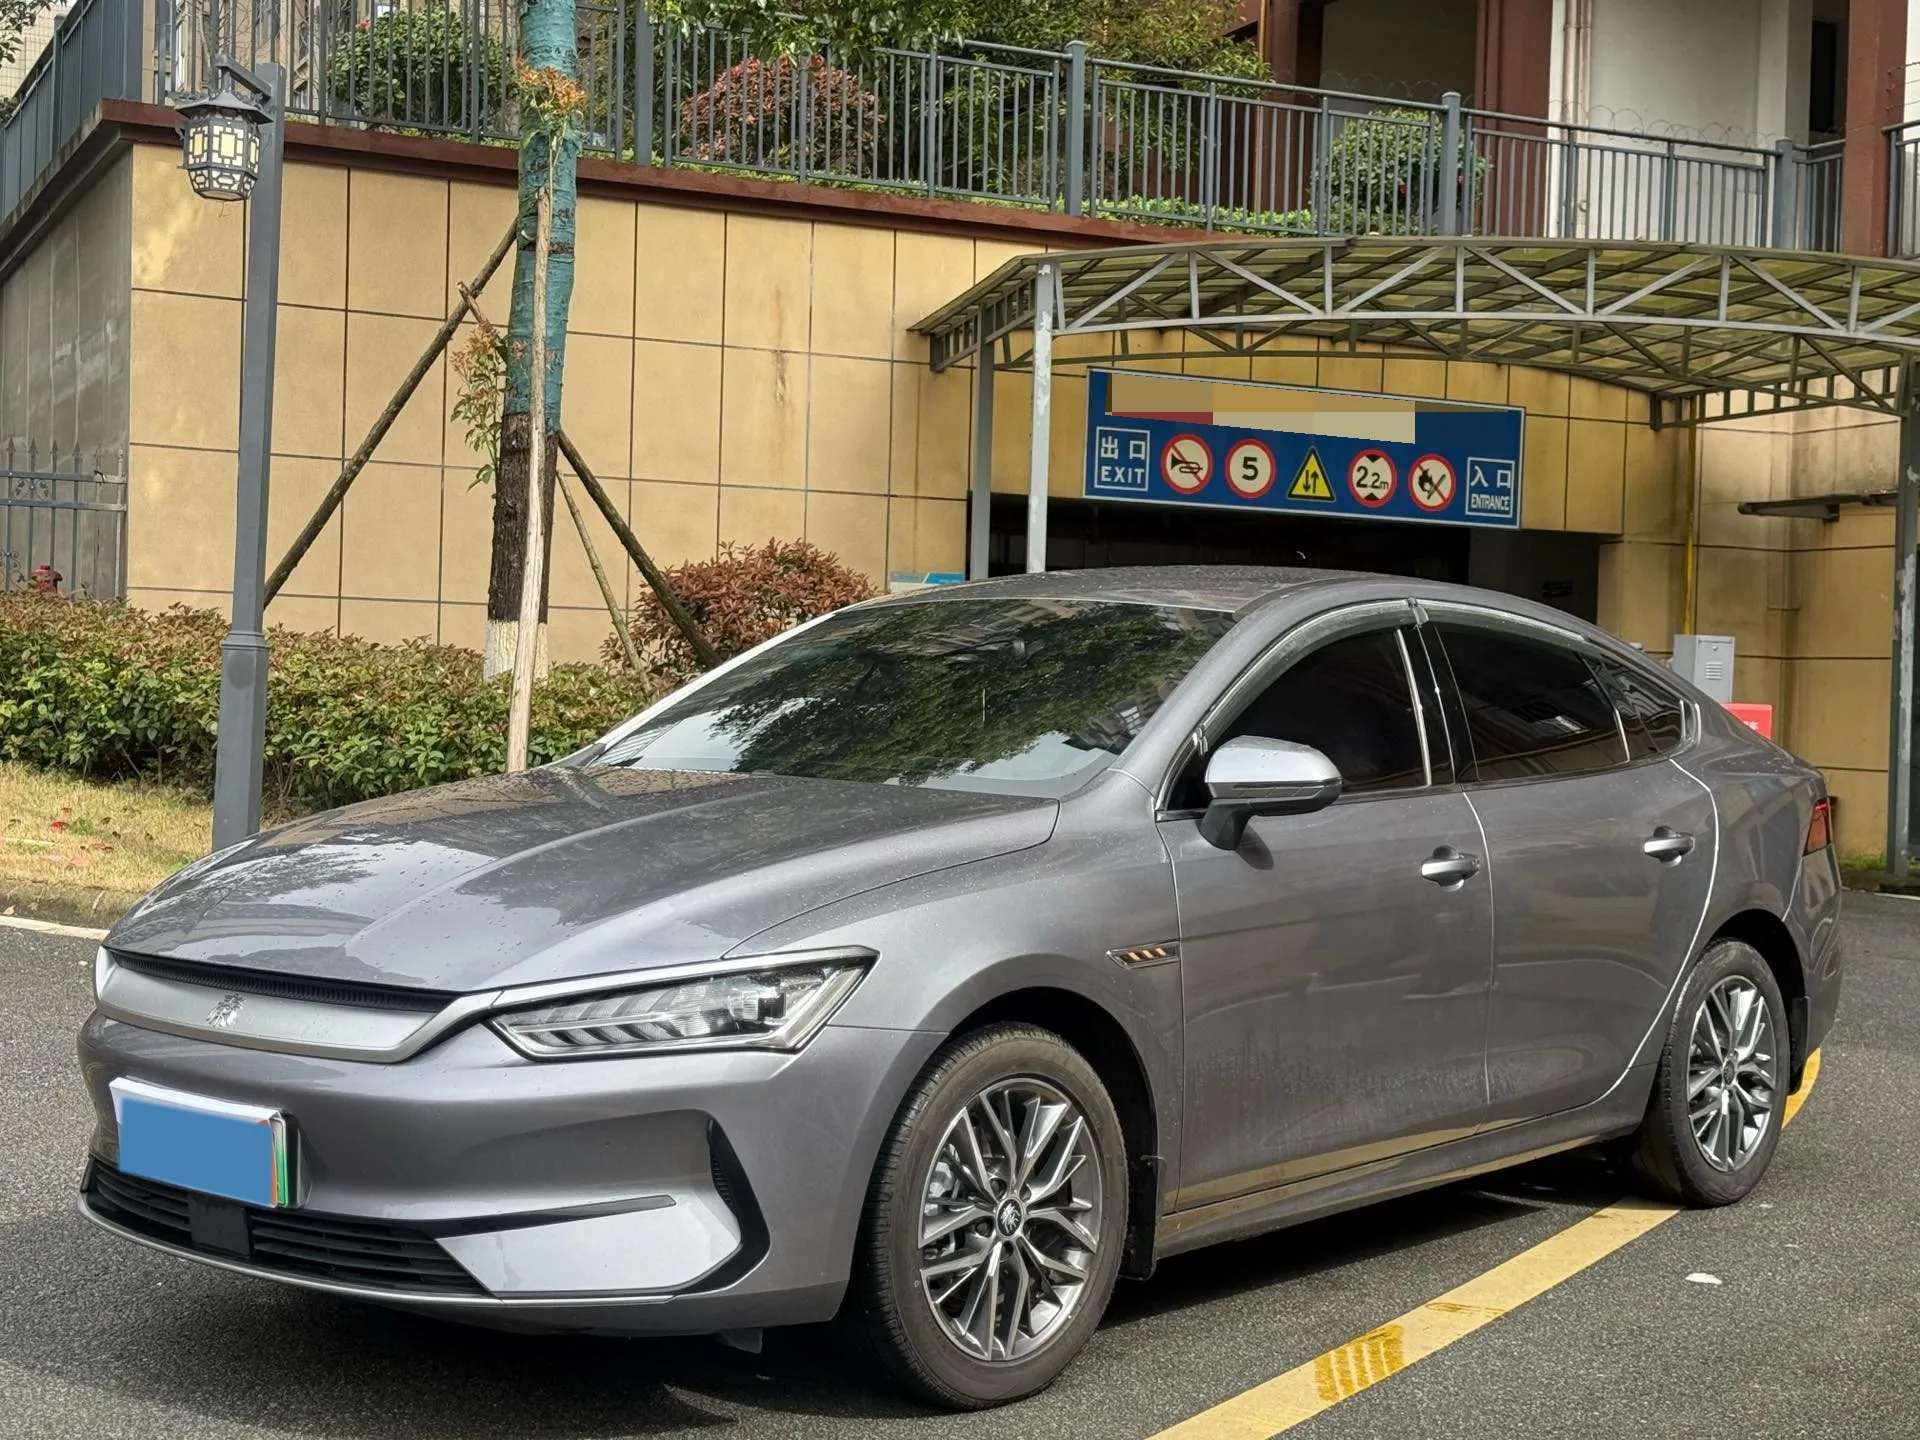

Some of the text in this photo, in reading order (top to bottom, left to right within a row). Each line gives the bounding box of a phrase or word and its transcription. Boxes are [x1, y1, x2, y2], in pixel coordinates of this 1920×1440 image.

[1100, 436, 1146, 460] 出口
[1100, 465, 1145, 484] EXIT
[1242, 456, 1259, 481] 5
[1470, 465, 1511, 488] 入口
[1471, 493, 1510, 511] ENTRANCE
